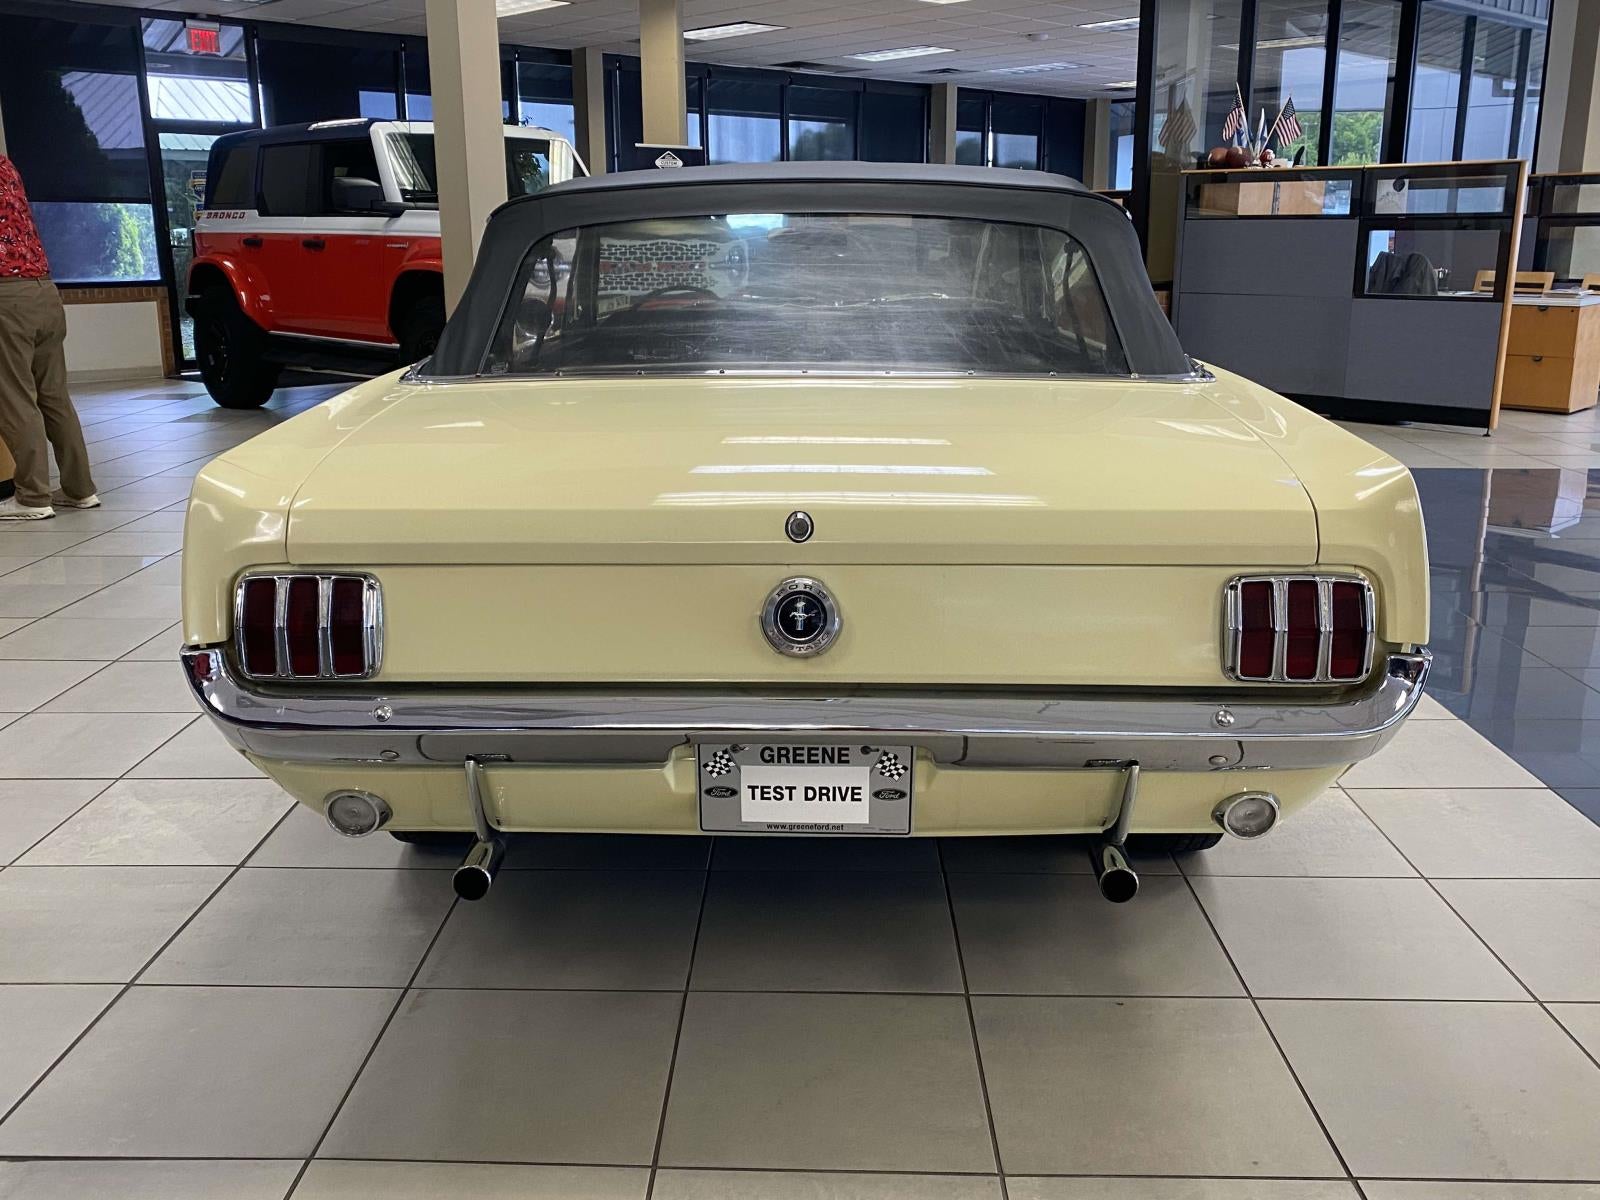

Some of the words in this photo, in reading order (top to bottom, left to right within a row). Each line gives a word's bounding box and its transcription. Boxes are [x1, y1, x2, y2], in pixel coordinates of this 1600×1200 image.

[191, 29, 217, 52] EXIT
[206, 211, 246, 220] BRONCO
[775, 583, 830, 600] FORD
[759, 746, 851, 765] GREENE
[747, 785, 797, 801] TEST
[803, 786, 863, 802] DRIVE
[766, 823, 844, 832] www.greeneford.net
